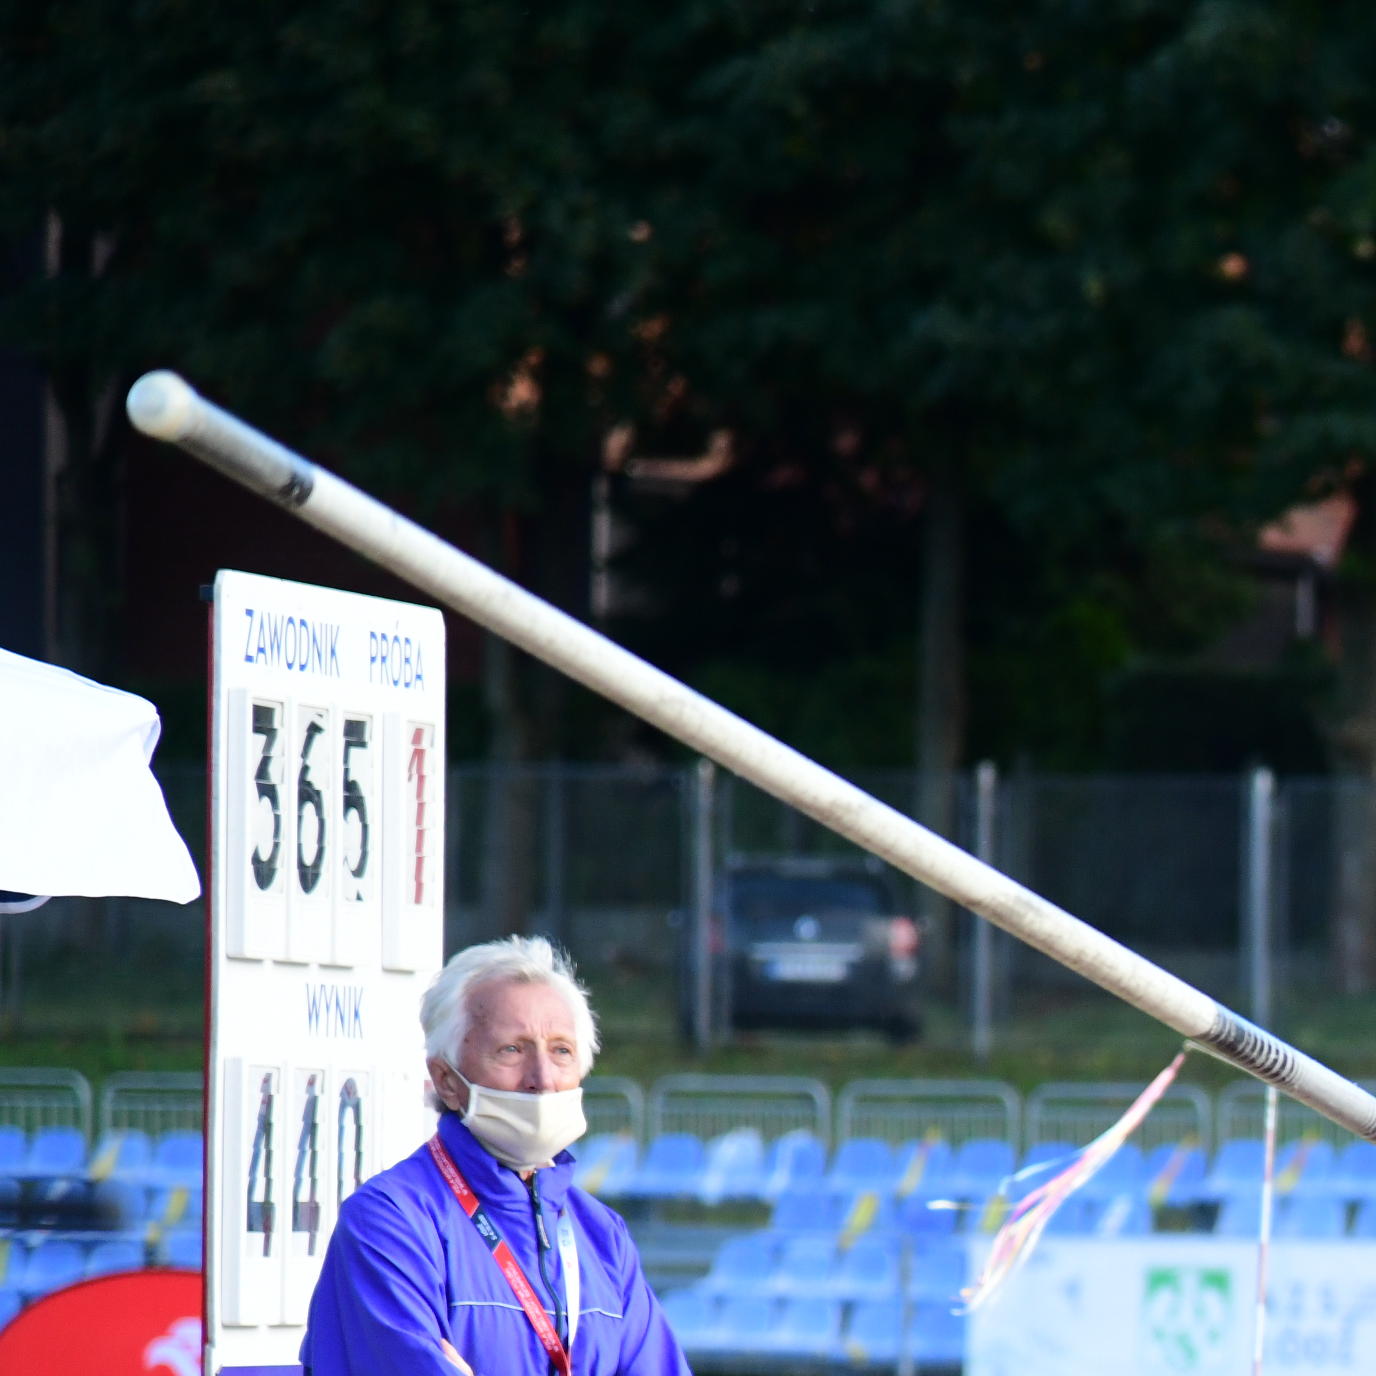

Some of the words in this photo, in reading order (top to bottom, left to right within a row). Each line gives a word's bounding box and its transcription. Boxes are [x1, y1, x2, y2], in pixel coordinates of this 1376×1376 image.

[244, 608, 341, 678] ZAWODNIK
[369, 620, 425, 692] PRÓBA
[251, 703, 371, 896] 365
[306, 982, 364, 1040] WYNIK
